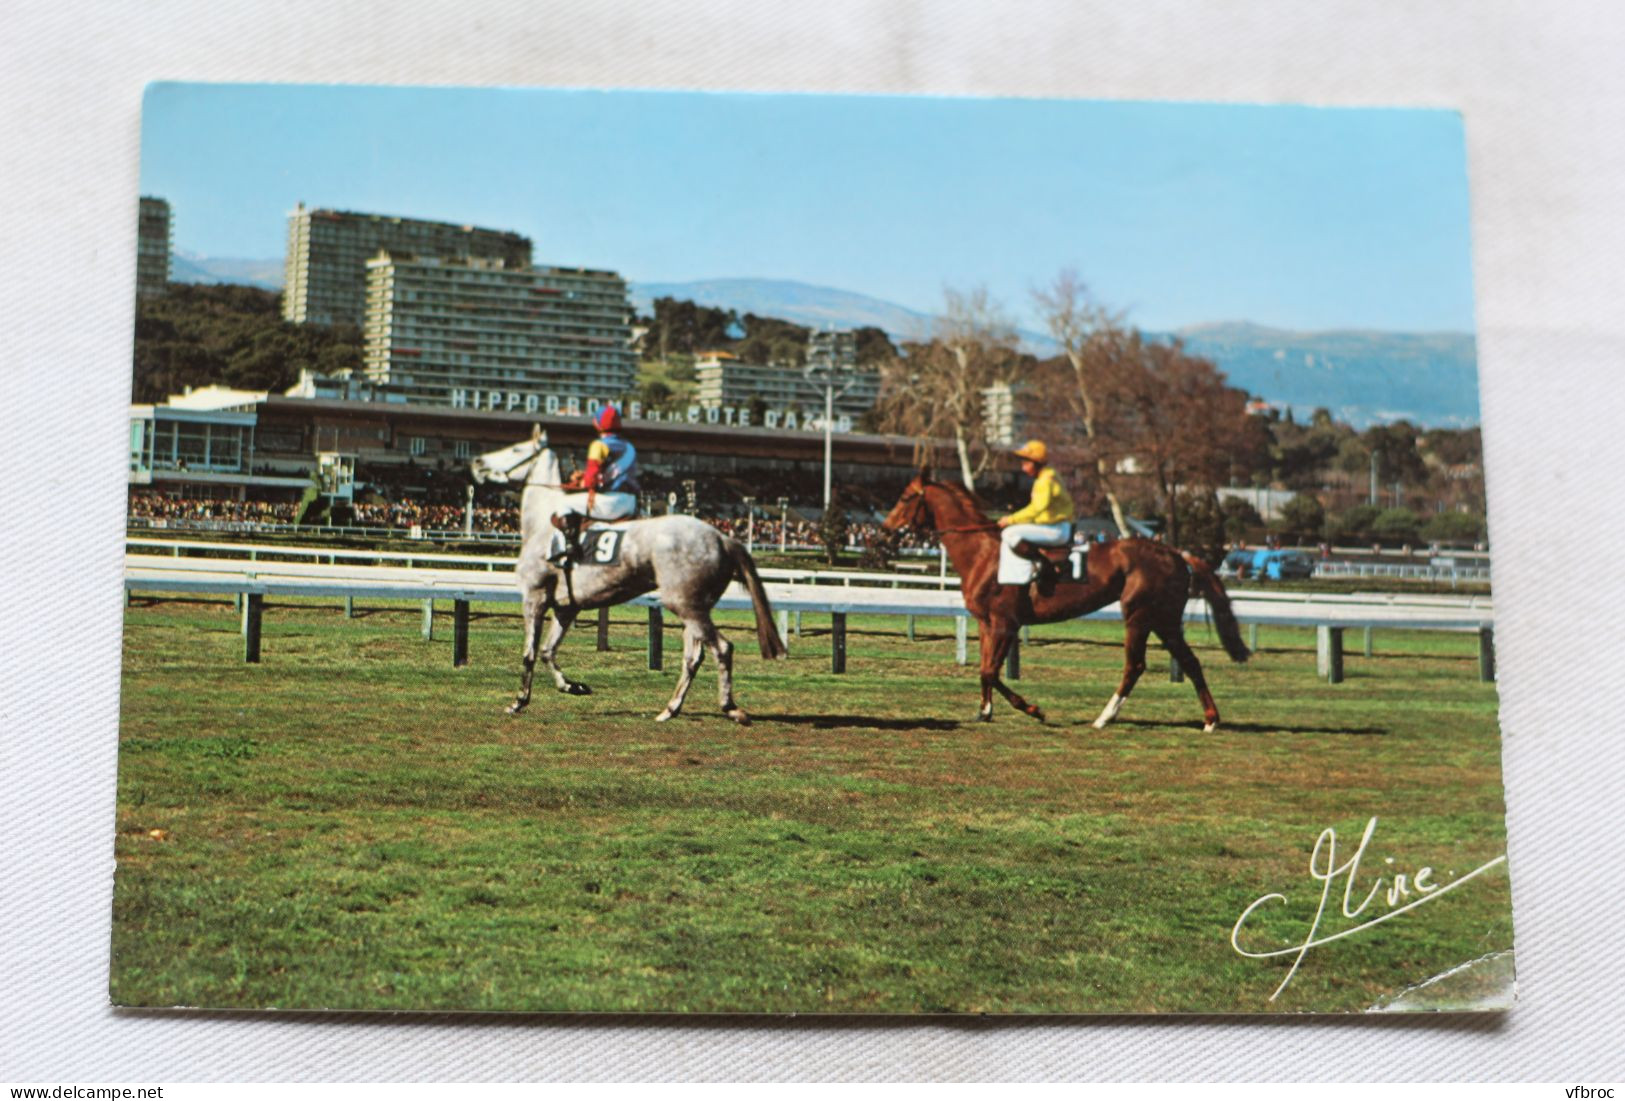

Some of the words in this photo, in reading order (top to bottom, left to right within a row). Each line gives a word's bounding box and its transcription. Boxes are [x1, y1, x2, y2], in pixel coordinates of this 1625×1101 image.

[452, 388, 642, 420] HIPPODROME
[595, 531, 618, 562] 9
[1068, 551, 1082, 579] 1
